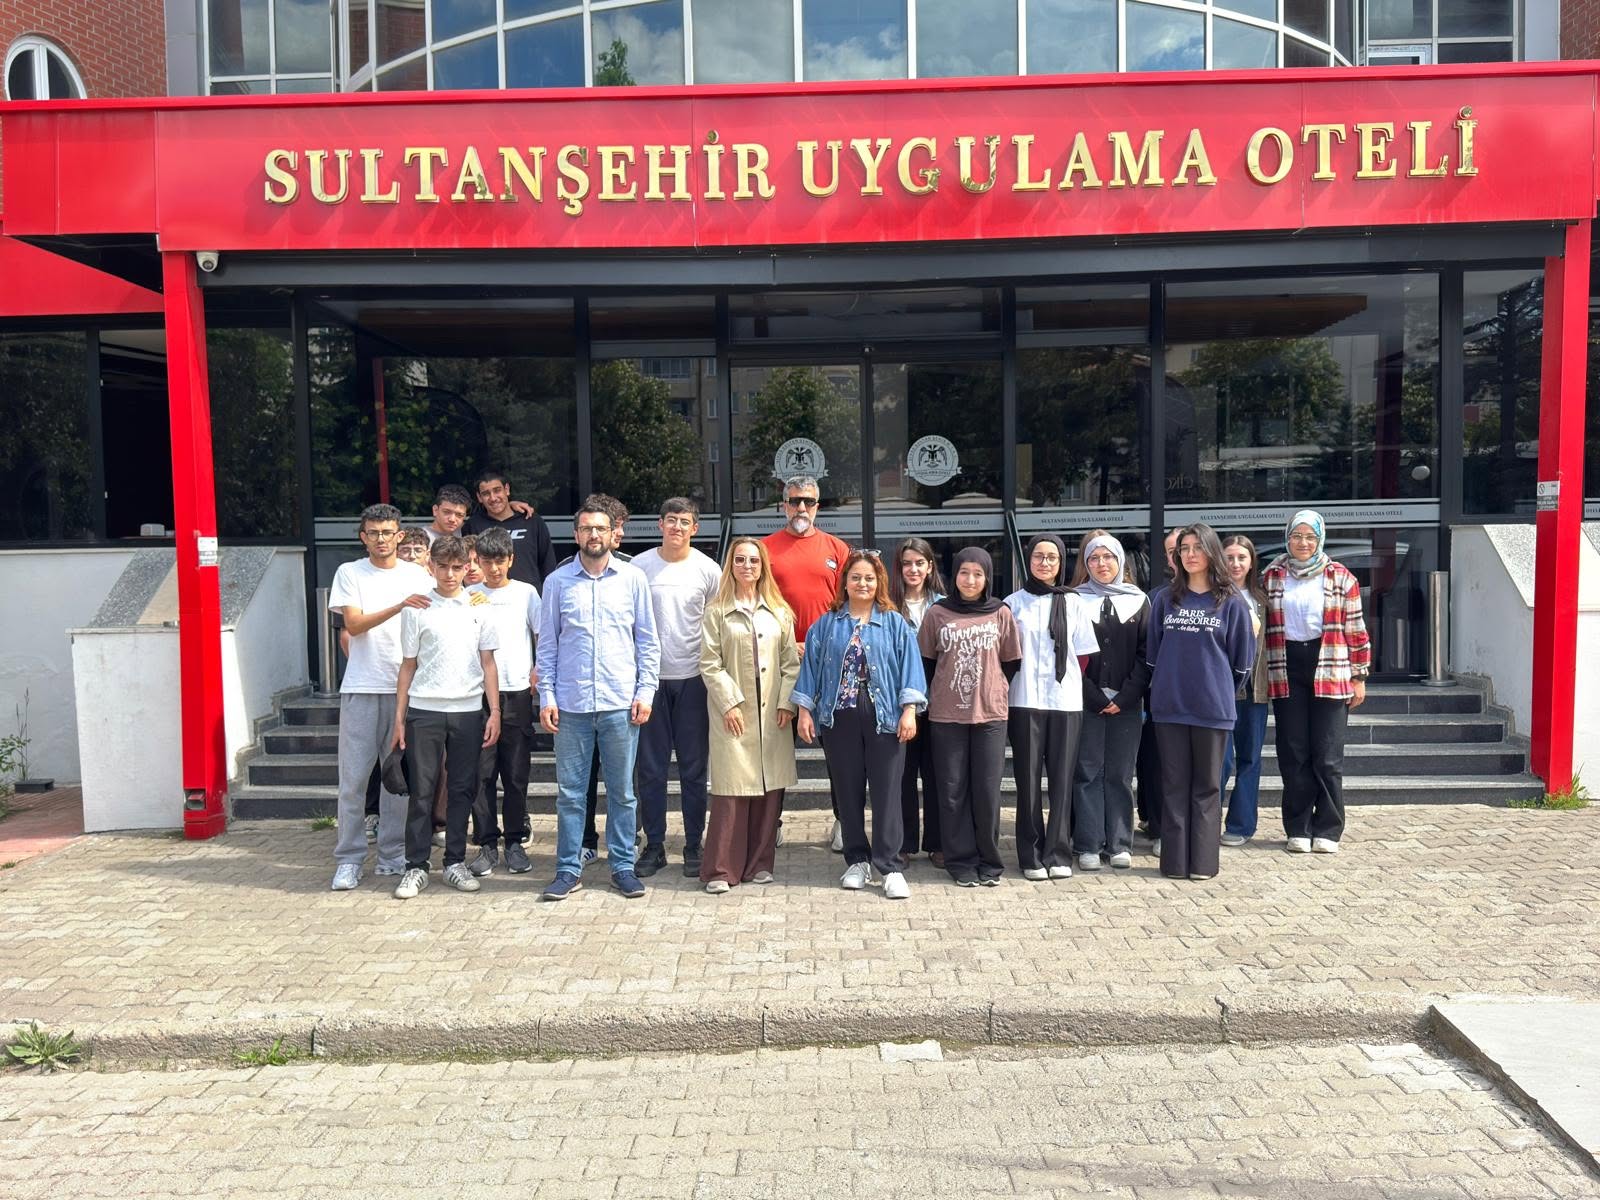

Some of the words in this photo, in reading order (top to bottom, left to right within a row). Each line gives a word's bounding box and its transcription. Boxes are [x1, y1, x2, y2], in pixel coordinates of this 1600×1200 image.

[264, 130, 775, 216] SULTANŞEHİR
[797, 128, 1218, 198] UYGULAMA
[1247, 105, 1479, 186] OTELİ
[1178, 608, 1205, 617] PARIS
